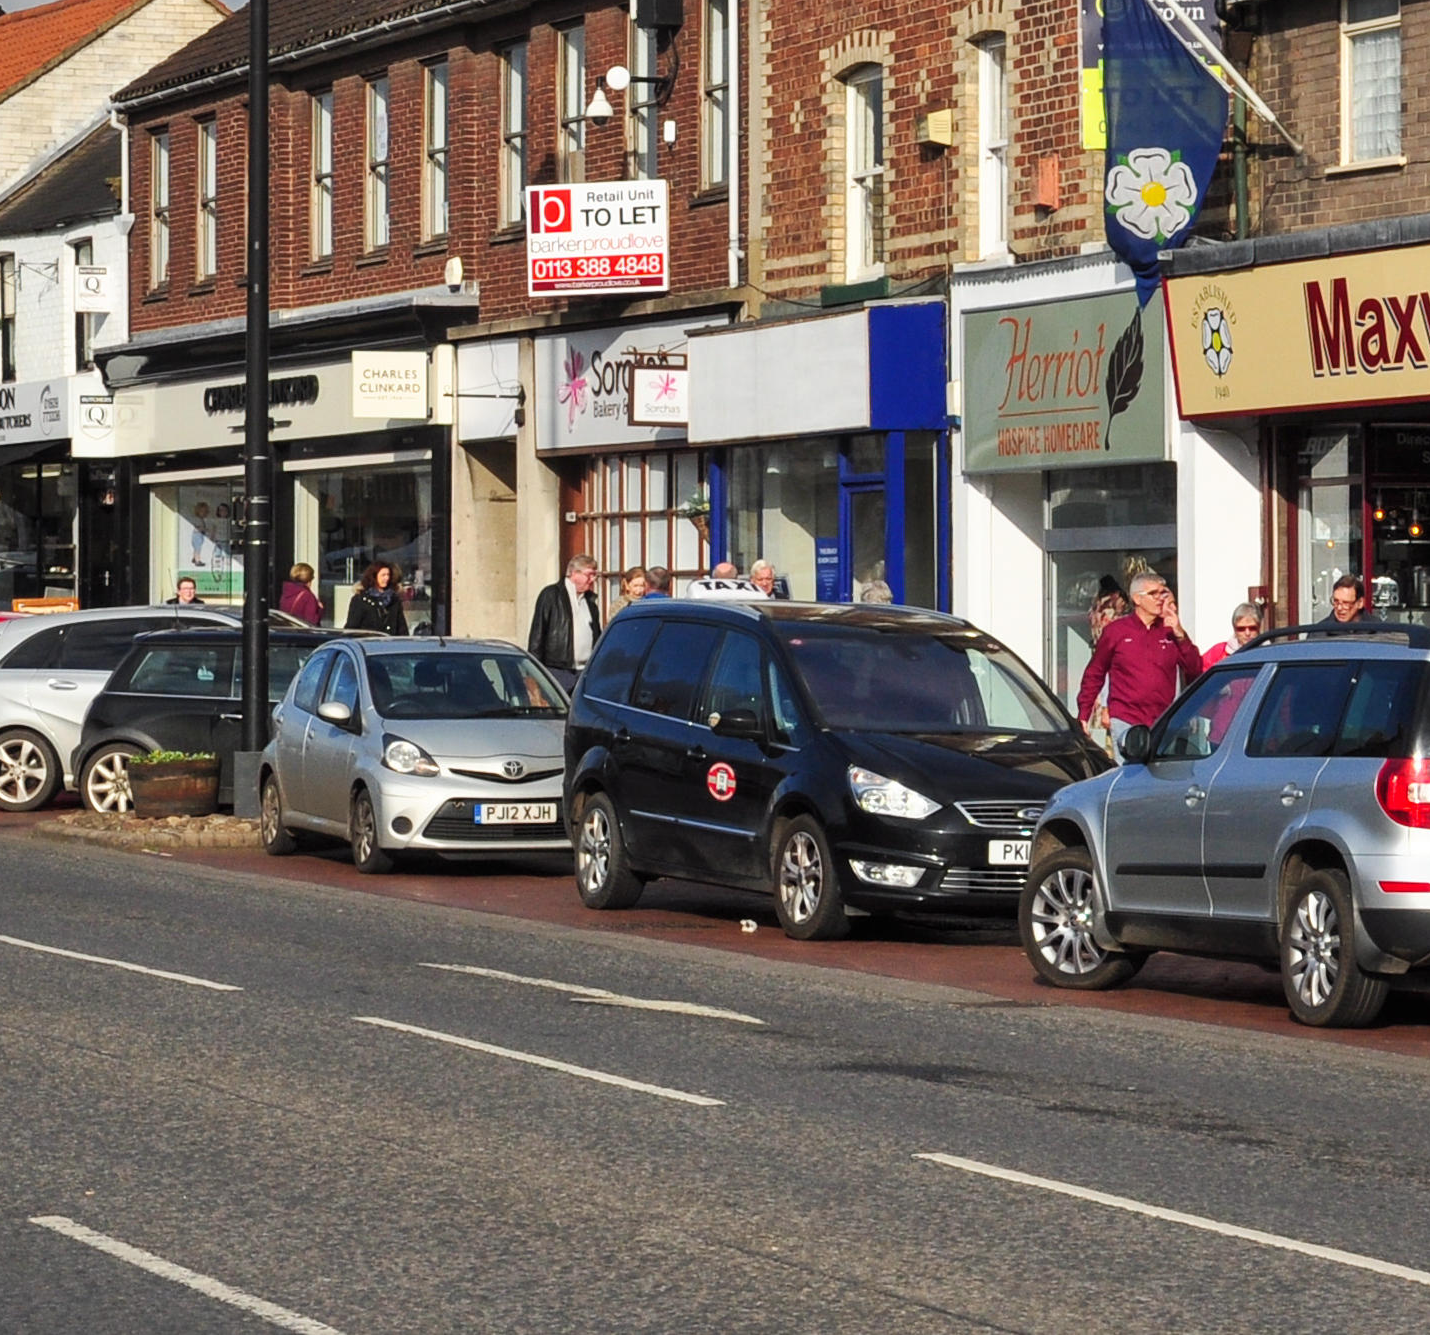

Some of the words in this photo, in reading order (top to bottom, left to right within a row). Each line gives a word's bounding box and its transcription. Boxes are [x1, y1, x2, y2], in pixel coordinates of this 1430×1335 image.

[587, 190, 623, 203] Retail
[628, 189, 654, 201] Unit
[580, 208, 611, 227] TO
[619, 205, 661, 225] LET
[530, 233, 664, 254] barkerproudlove
[534, 259, 572, 278] 0113
[576, 258, 611, 276] 388
[614, 255, 660, 274] 4848
[1191, 284, 1237, 330] ESTABLISHED
[998, 317, 1106, 410] Herriot
[363, 369, 418, 380] CHARLES
[359, 383, 421, 394] CLINKARD
[593, 401, 621, 420] Bakery
[998, 426, 1041, 457] HOSPICE
[1043, 421, 1101, 454] HOMECARE
[698, 580, 761, 592] TAXI
[486, 806, 519, 821] PJ12
[523, 805, 551, 820] XJH
